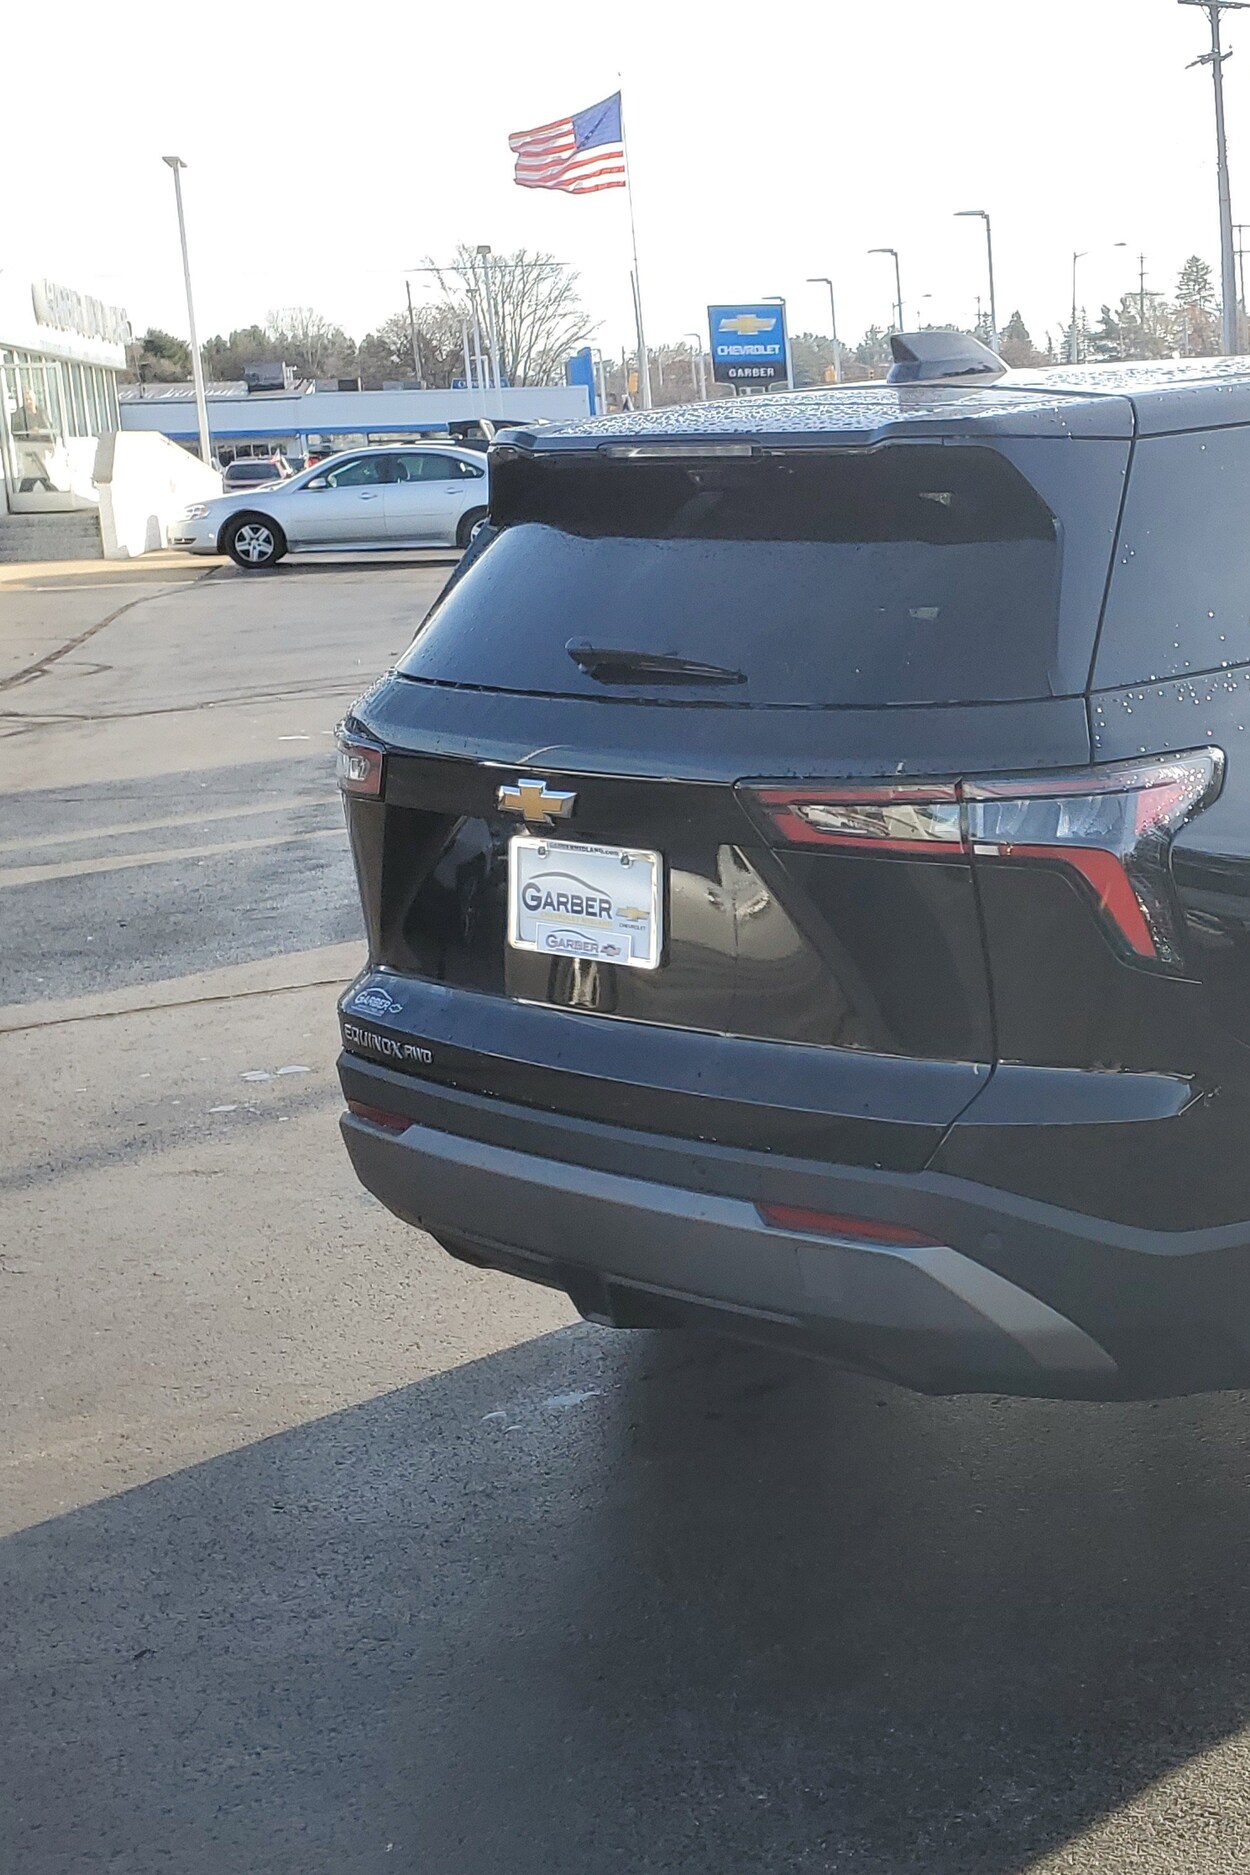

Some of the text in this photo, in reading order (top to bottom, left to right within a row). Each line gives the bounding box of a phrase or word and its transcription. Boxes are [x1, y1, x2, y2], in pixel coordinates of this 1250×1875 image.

[717, 345, 780, 355] CHEVROLET
[728, 368, 774, 378] GARBER
[522, 882, 613, 919] GARBER
[546, 934, 599, 953] GARBER
[355, 991, 391, 1010] GARBER
[344, 1024, 403, 1059] EQUINOX
